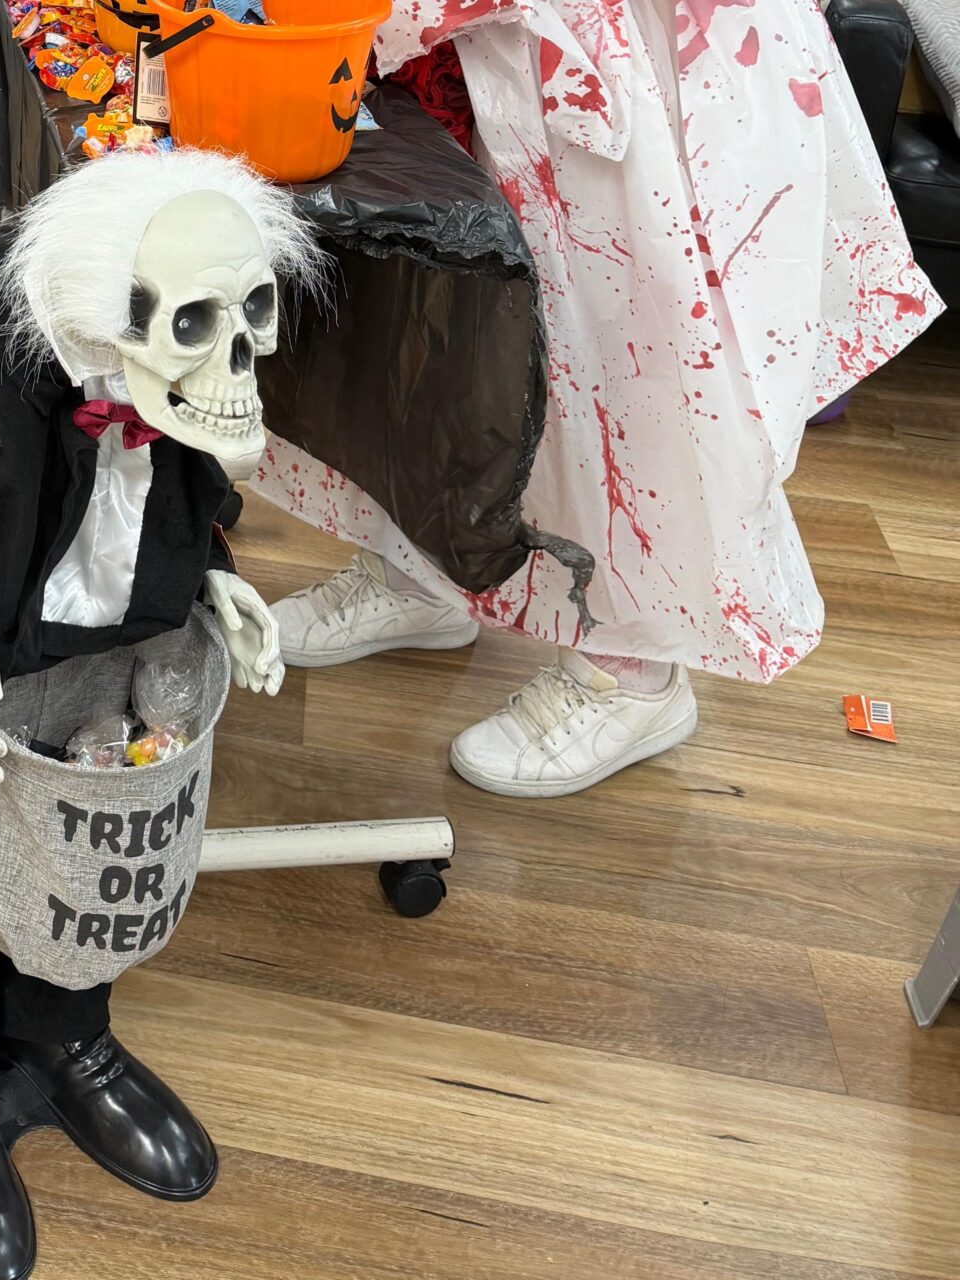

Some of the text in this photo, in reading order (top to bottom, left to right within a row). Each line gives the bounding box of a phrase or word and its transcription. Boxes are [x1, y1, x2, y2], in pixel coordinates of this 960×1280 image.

[57, 770, 200, 858] TRICK
[47, 879, 187, 953] TREAT
[98, 862, 165, 904] OR
